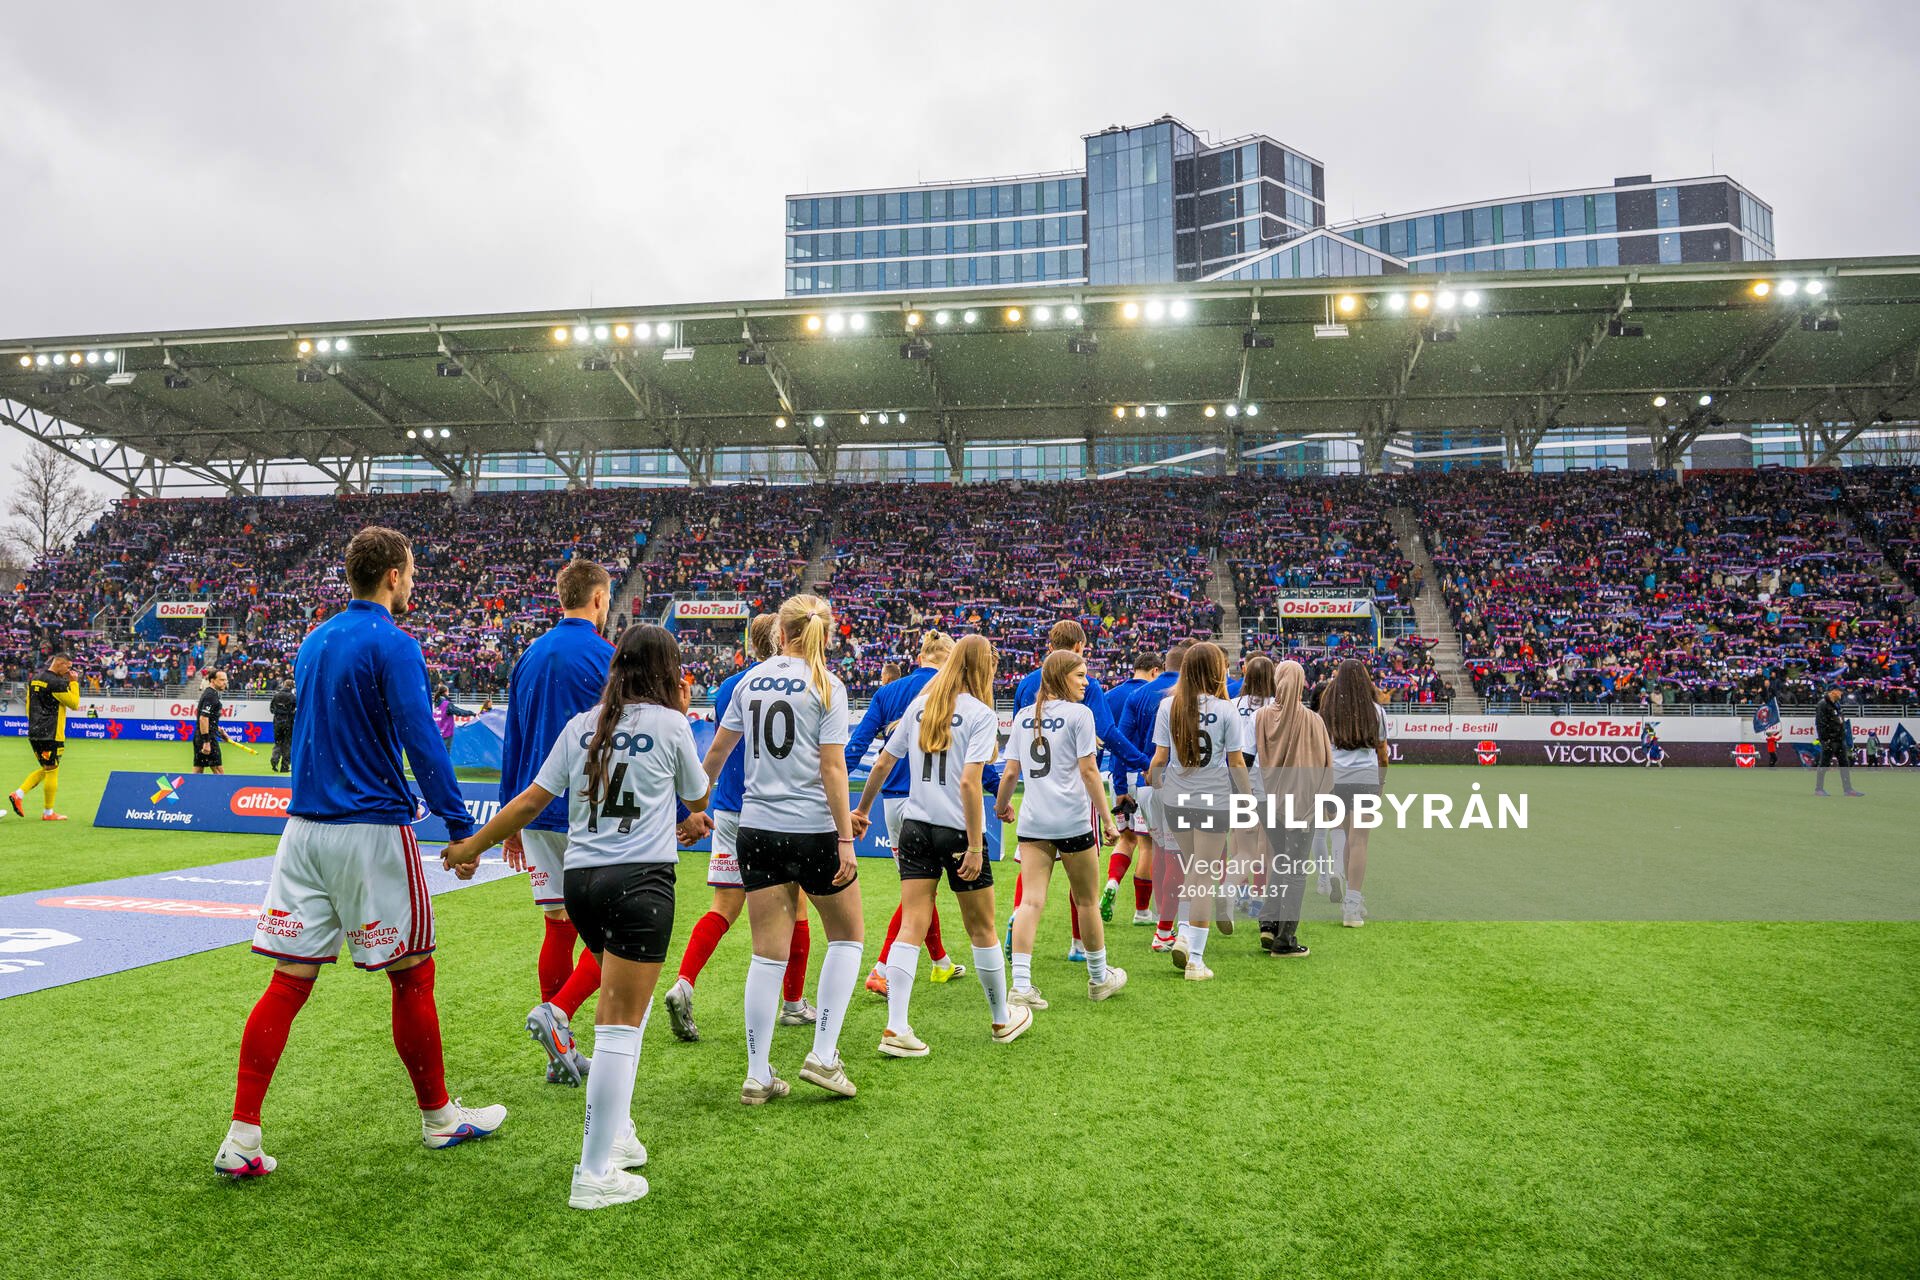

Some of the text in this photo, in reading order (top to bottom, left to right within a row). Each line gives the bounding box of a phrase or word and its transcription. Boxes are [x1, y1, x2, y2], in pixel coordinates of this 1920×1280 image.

[160, 604, 206, 615] OsloTax
[679, 603, 740, 615] OsloTaxi
[1283, 601, 1352, 614] OsloTaxi
[749, 677, 807, 695] coop
[749, 700, 796, 760] 10
[1404, 723, 1427, 732] Last
[1430, 723, 1453, 732] ned
[1462, 723, 1498, 732] Bestill
[1550, 721, 1642, 737] OsloTaxi
[1790, 725, 1814, 735] Last
[580, 732, 654, 756] cop
[1030, 736, 1051, 778] 9
[237, 793, 291, 810] altibo
[583, 762, 641, 833] 14
[126, 809, 193, 824] Norsk Tipping
[820, 1008, 830, 1032] umbro
[748, 1029, 757, 1055] umbro
[584, 1104, 592, 1136] umbro
